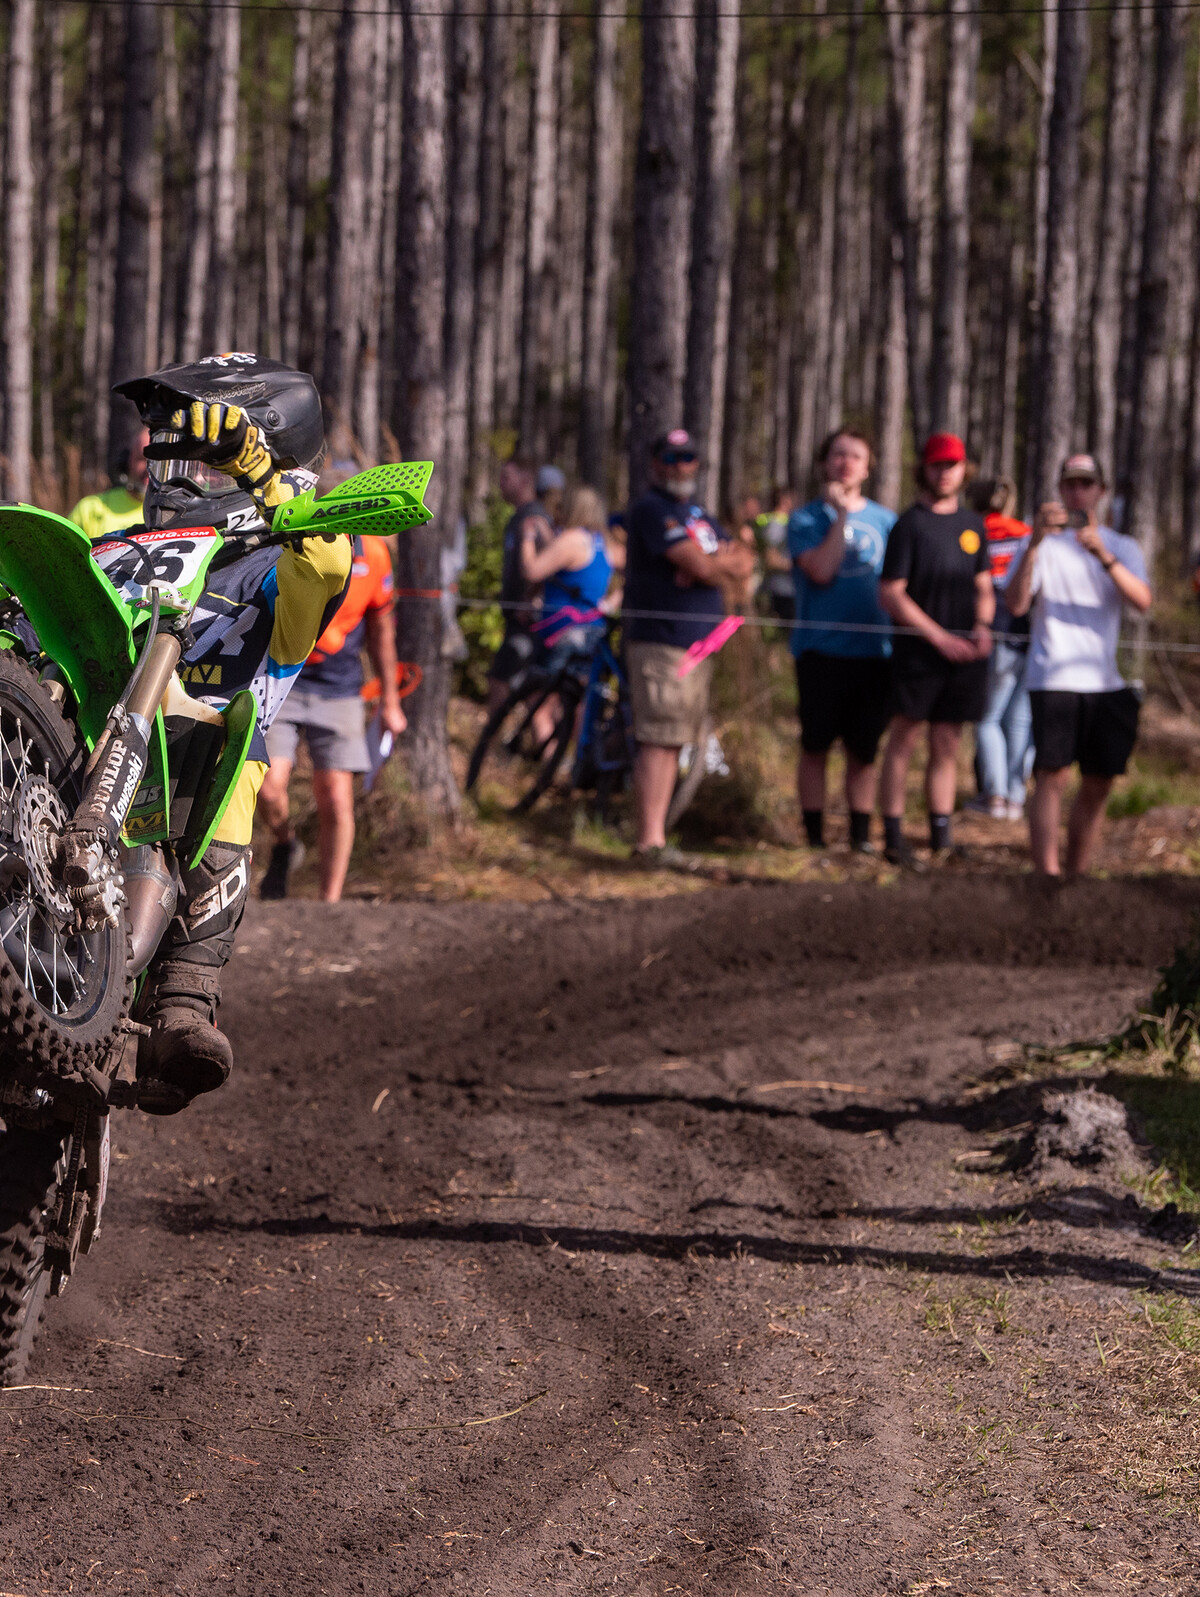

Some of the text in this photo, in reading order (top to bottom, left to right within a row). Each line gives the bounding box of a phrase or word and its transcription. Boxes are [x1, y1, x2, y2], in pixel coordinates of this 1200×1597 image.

[311, 497, 391, 519] ACERBIS
[89, 739, 128, 820] DUNLOP
[109, 751, 144, 828] Kawasaki
